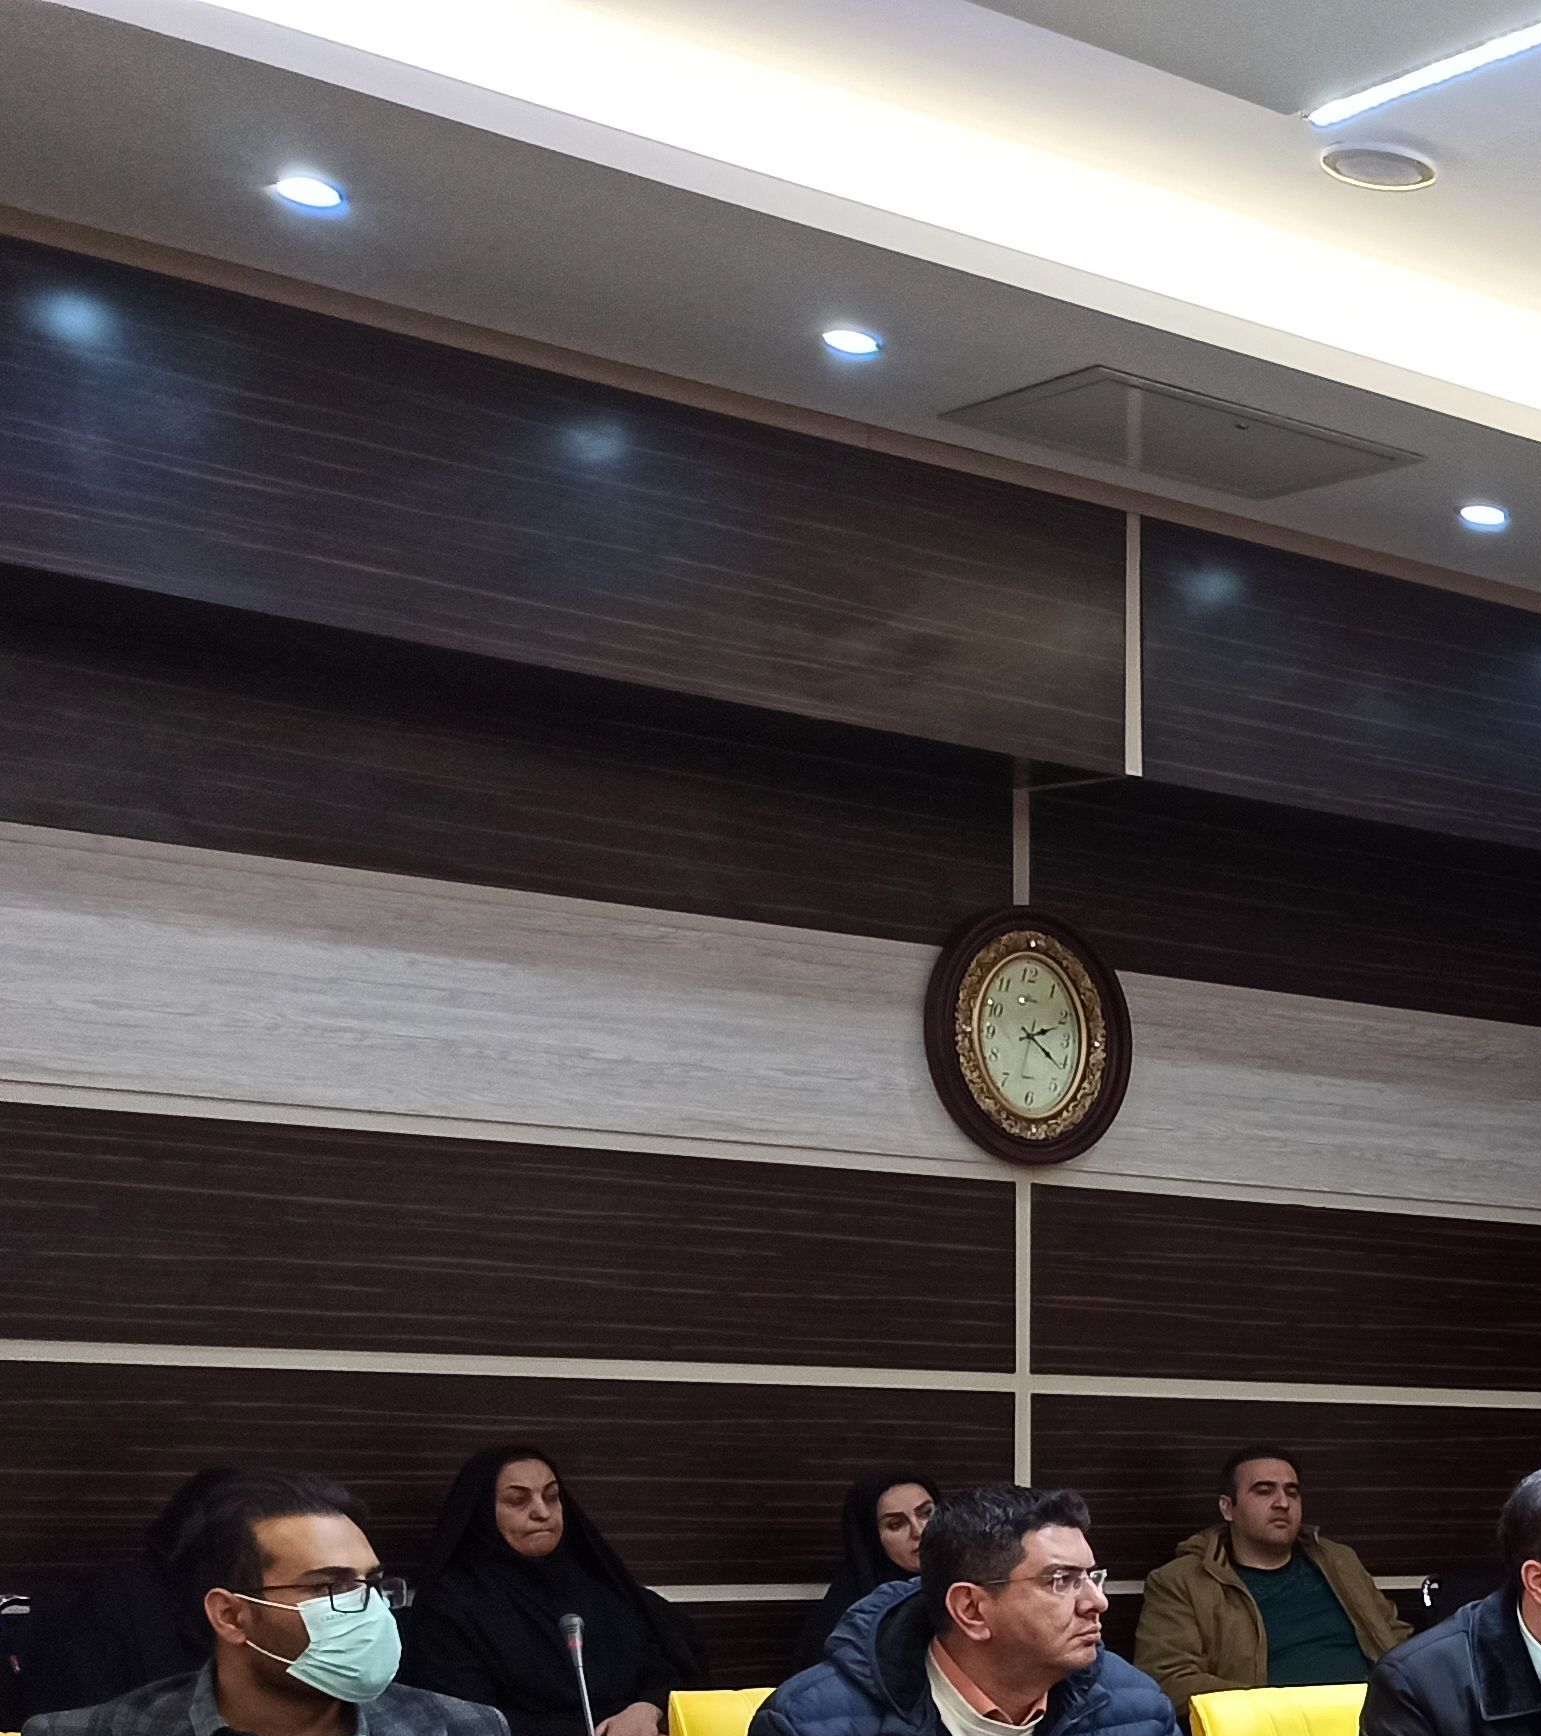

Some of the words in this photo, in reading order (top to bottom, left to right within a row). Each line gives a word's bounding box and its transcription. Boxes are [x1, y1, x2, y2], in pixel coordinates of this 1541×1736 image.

[1022, 967, 1039, 984] 12
[998, 977, 1011, 992] 11
[1050, 984, 1056, 999] 1
[988, 1003, 1003, 1018] 10
[1058, 1010, 1068, 1025] 2
[986, 1024, 996, 1039] 9
[1061, 1032, 1070, 1049] 3
[989, 1047, 999, 1062] 8
[1001, 1072, 1010, 1087] 7
[1024, 1090, 1034, 1106] 6
